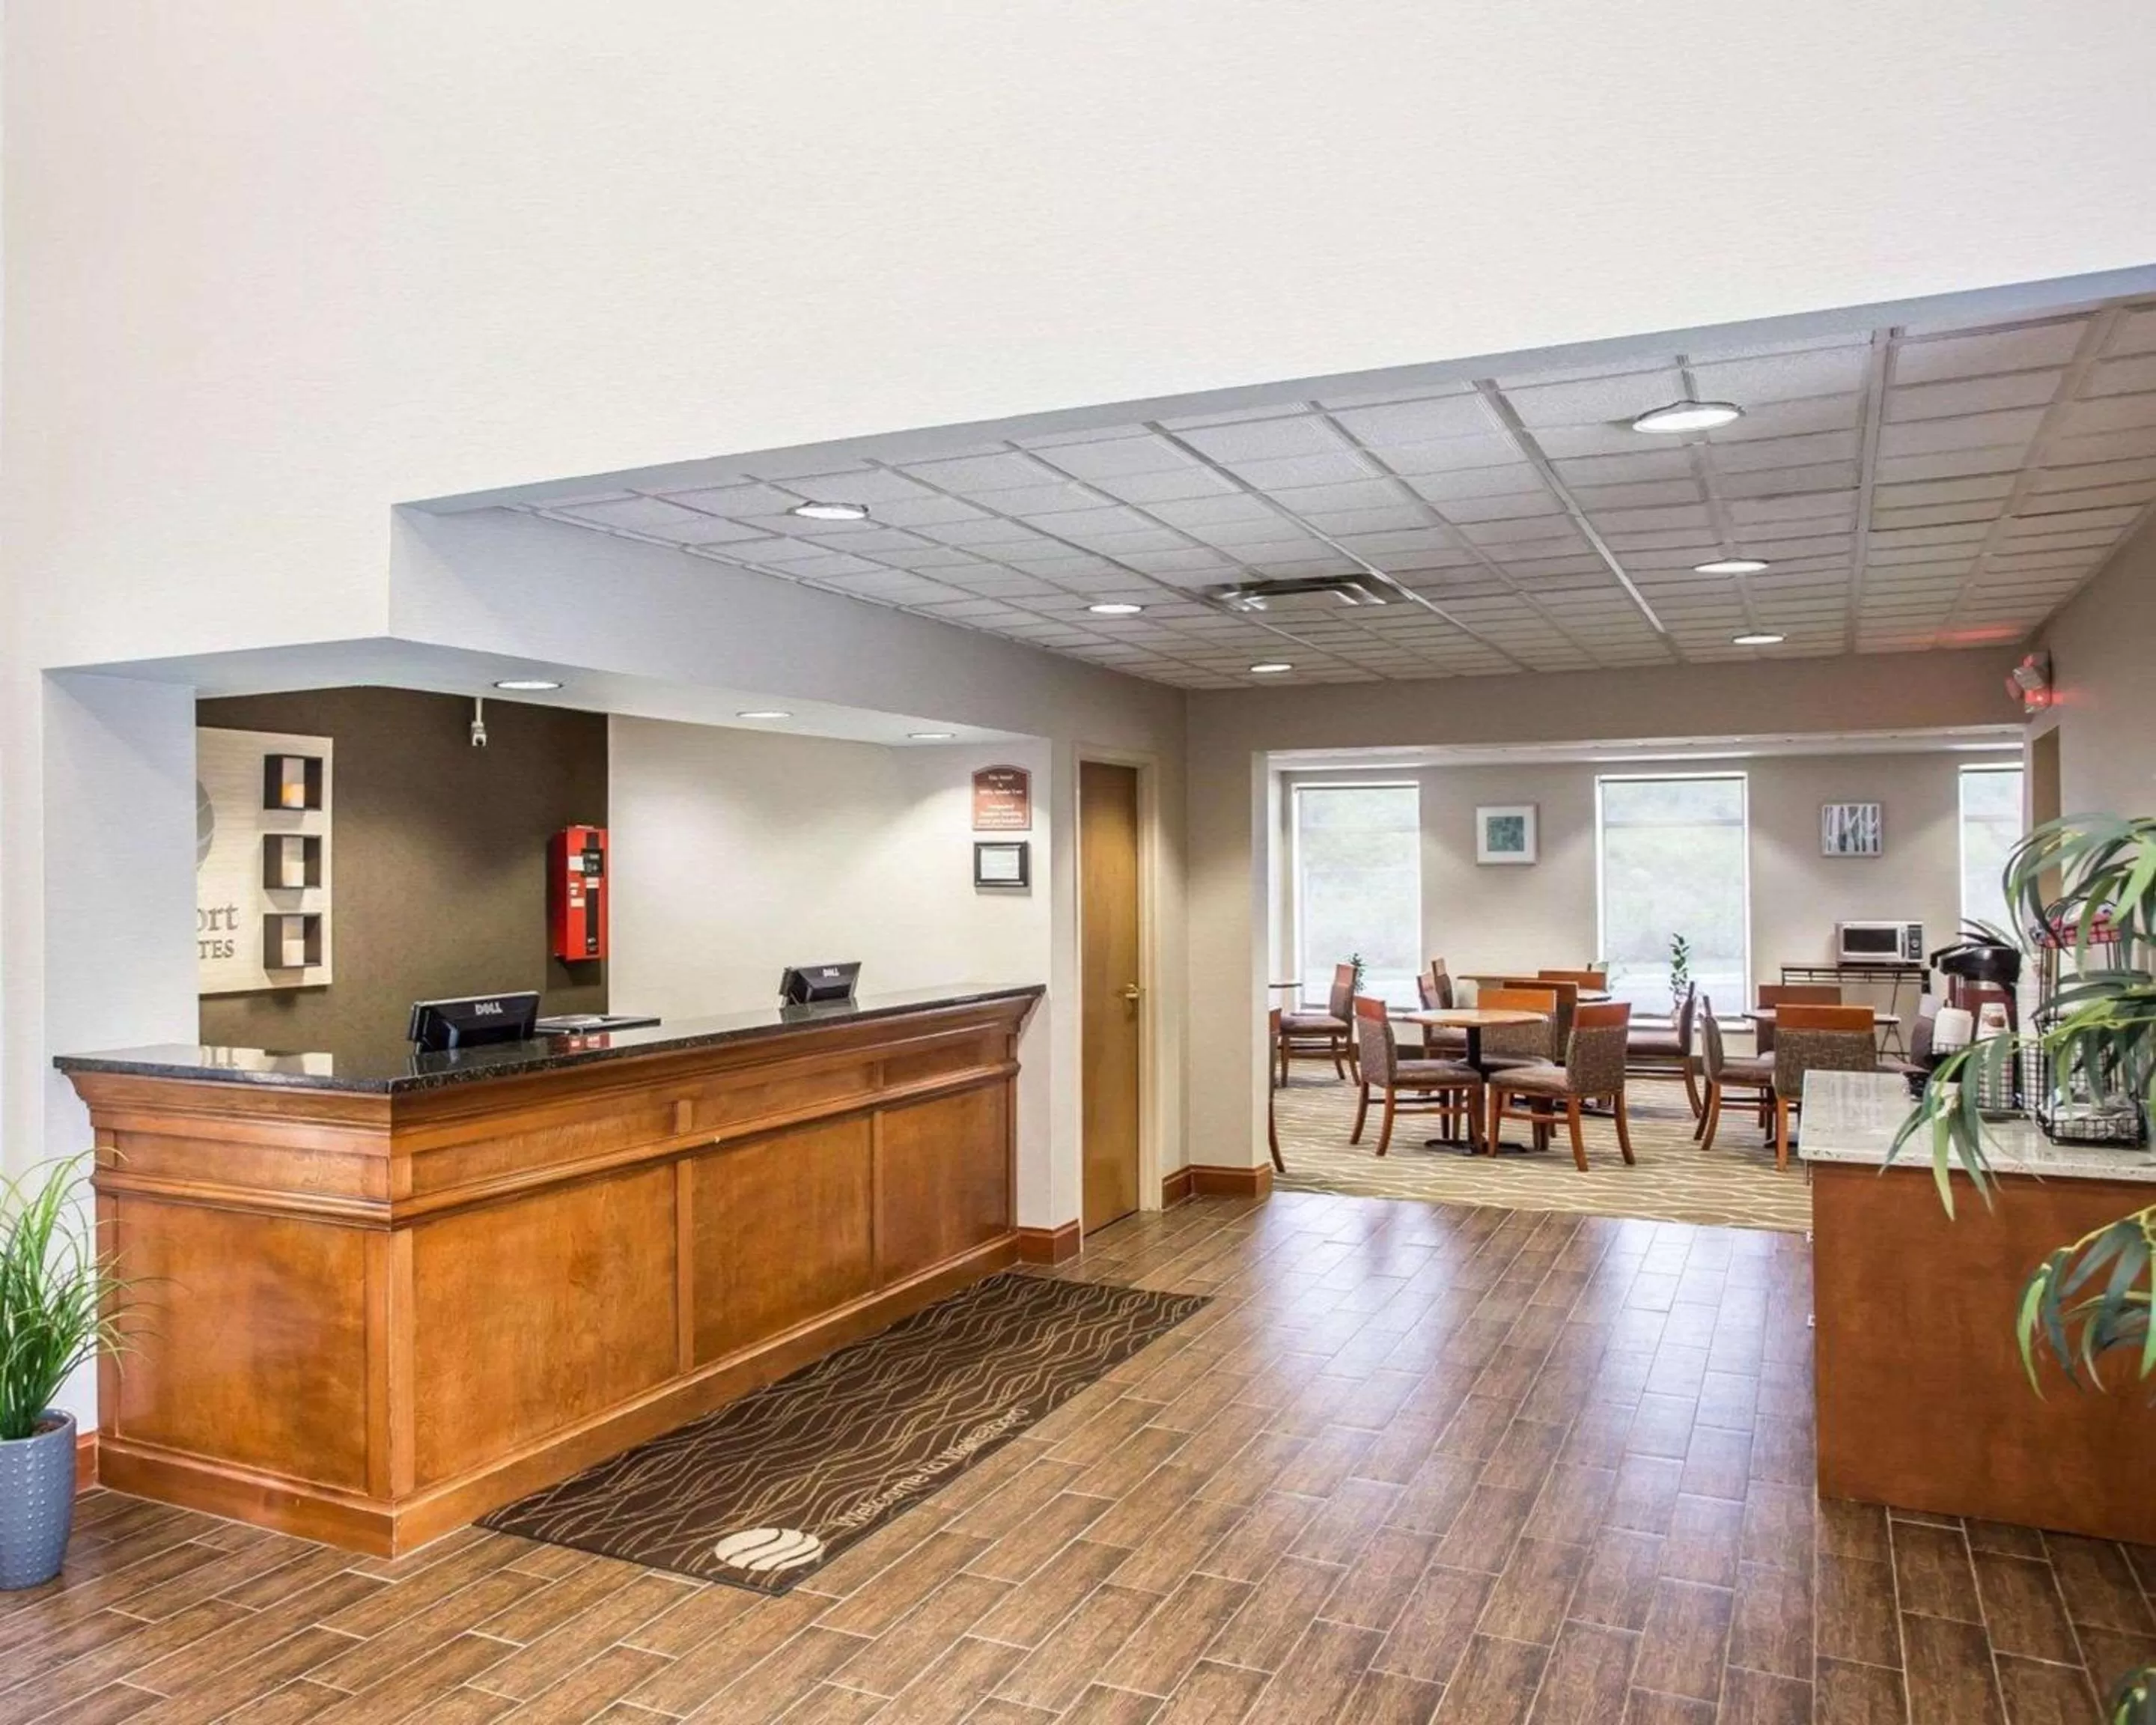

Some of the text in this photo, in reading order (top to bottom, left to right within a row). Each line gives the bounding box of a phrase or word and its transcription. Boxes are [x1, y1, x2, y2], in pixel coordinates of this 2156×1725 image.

[823, 967, 839, 977] DELL
[475, 1001, 503, 1015] DELL
[833, 1473, 931, 1527] Welcome
[918, 1461, 949, 1474] to
